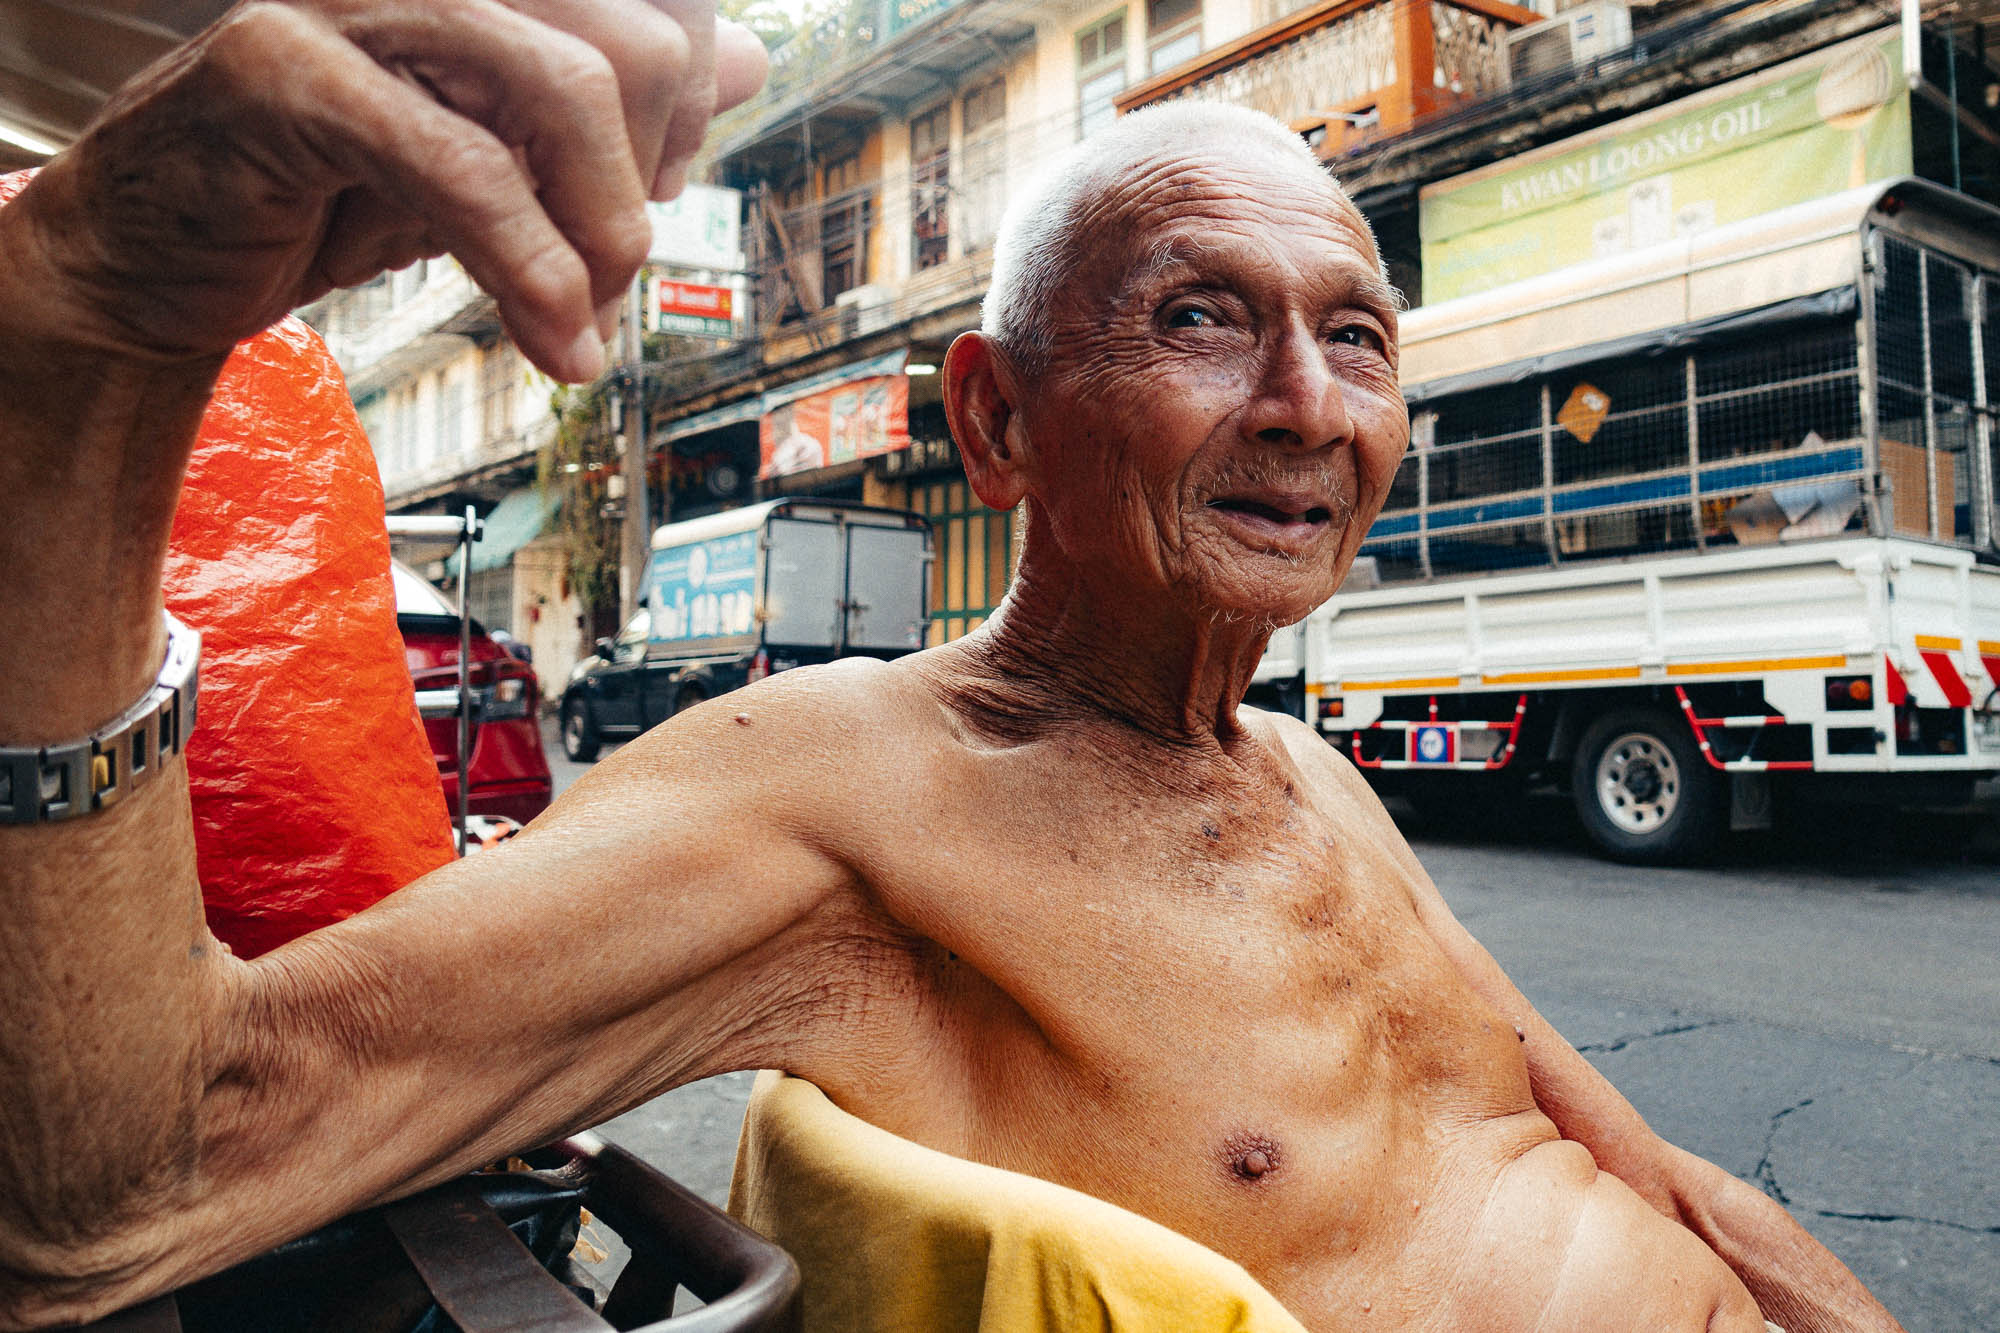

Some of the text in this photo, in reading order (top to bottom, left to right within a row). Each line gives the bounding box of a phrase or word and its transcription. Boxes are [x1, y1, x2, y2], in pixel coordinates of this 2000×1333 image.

[1502, 101, 1766, 209] KWAN LOONG OIL
